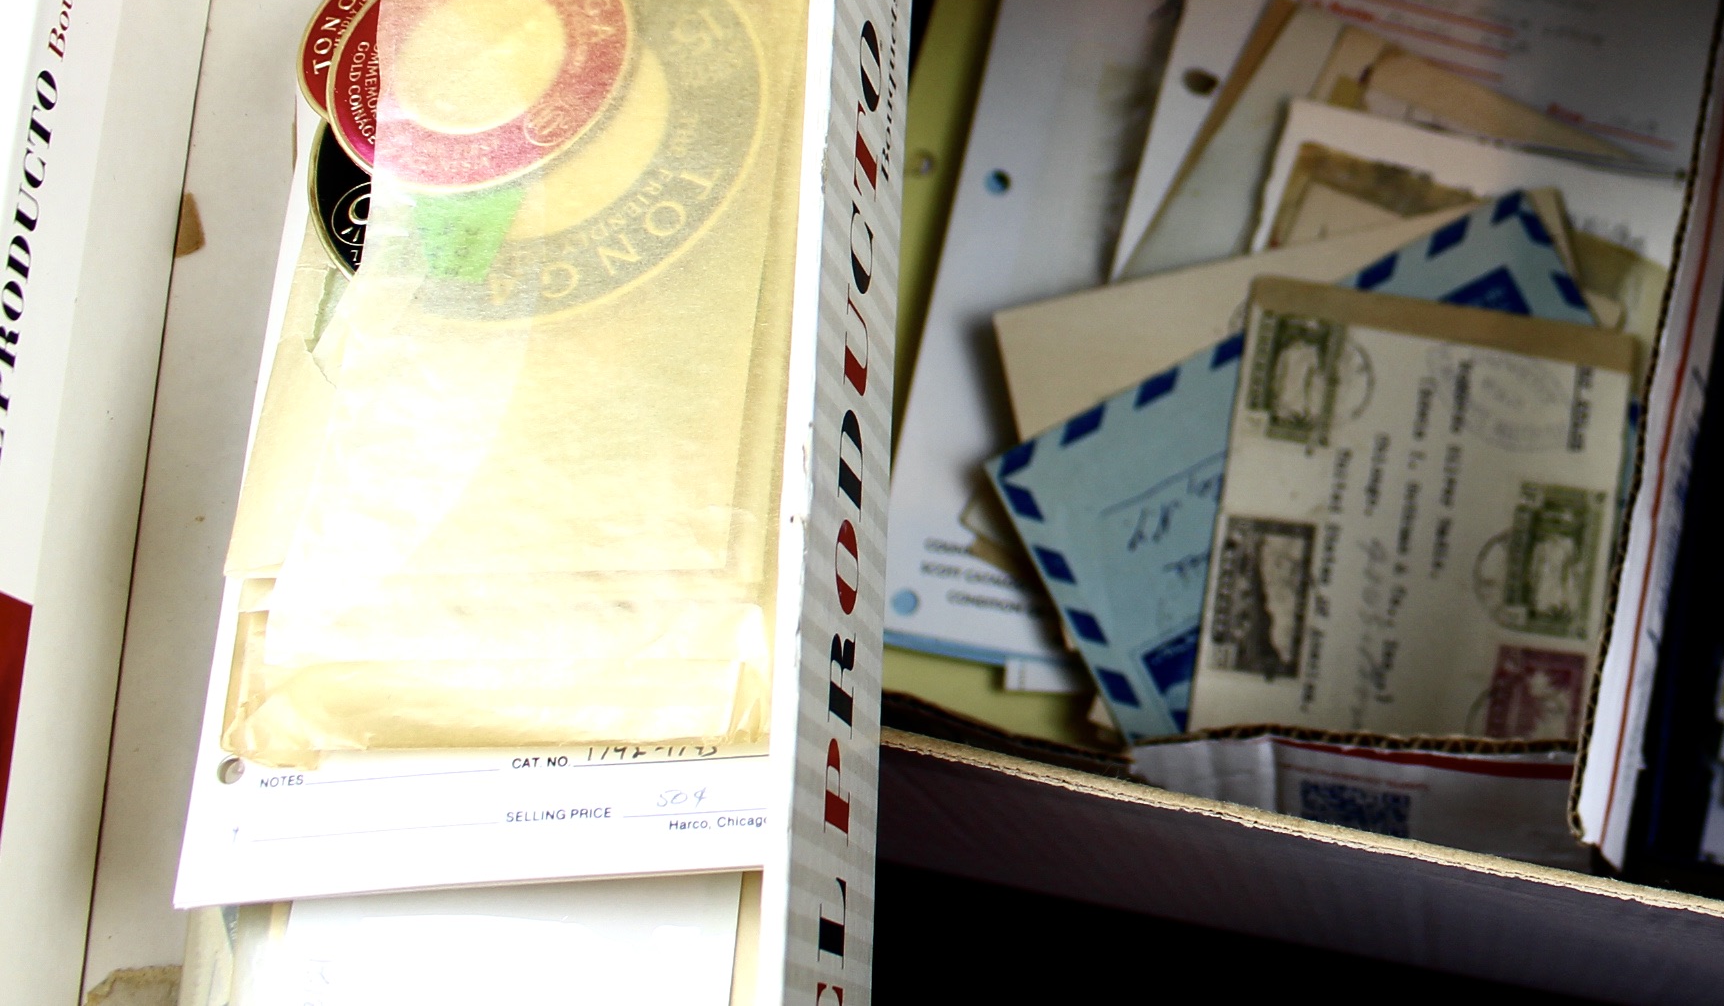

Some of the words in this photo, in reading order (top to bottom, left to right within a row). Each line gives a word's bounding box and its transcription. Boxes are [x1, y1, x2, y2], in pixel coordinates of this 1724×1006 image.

[350, 41, 370, 83] GOLD
[823, 20, 883, 847] PRODUCTO
[259, 774, 305, 790] NOTES
[505, 808, 567, 822] SELLING
[570, 807, 612, 820] PRICE
[668, 817, 712, 832] Harco,
